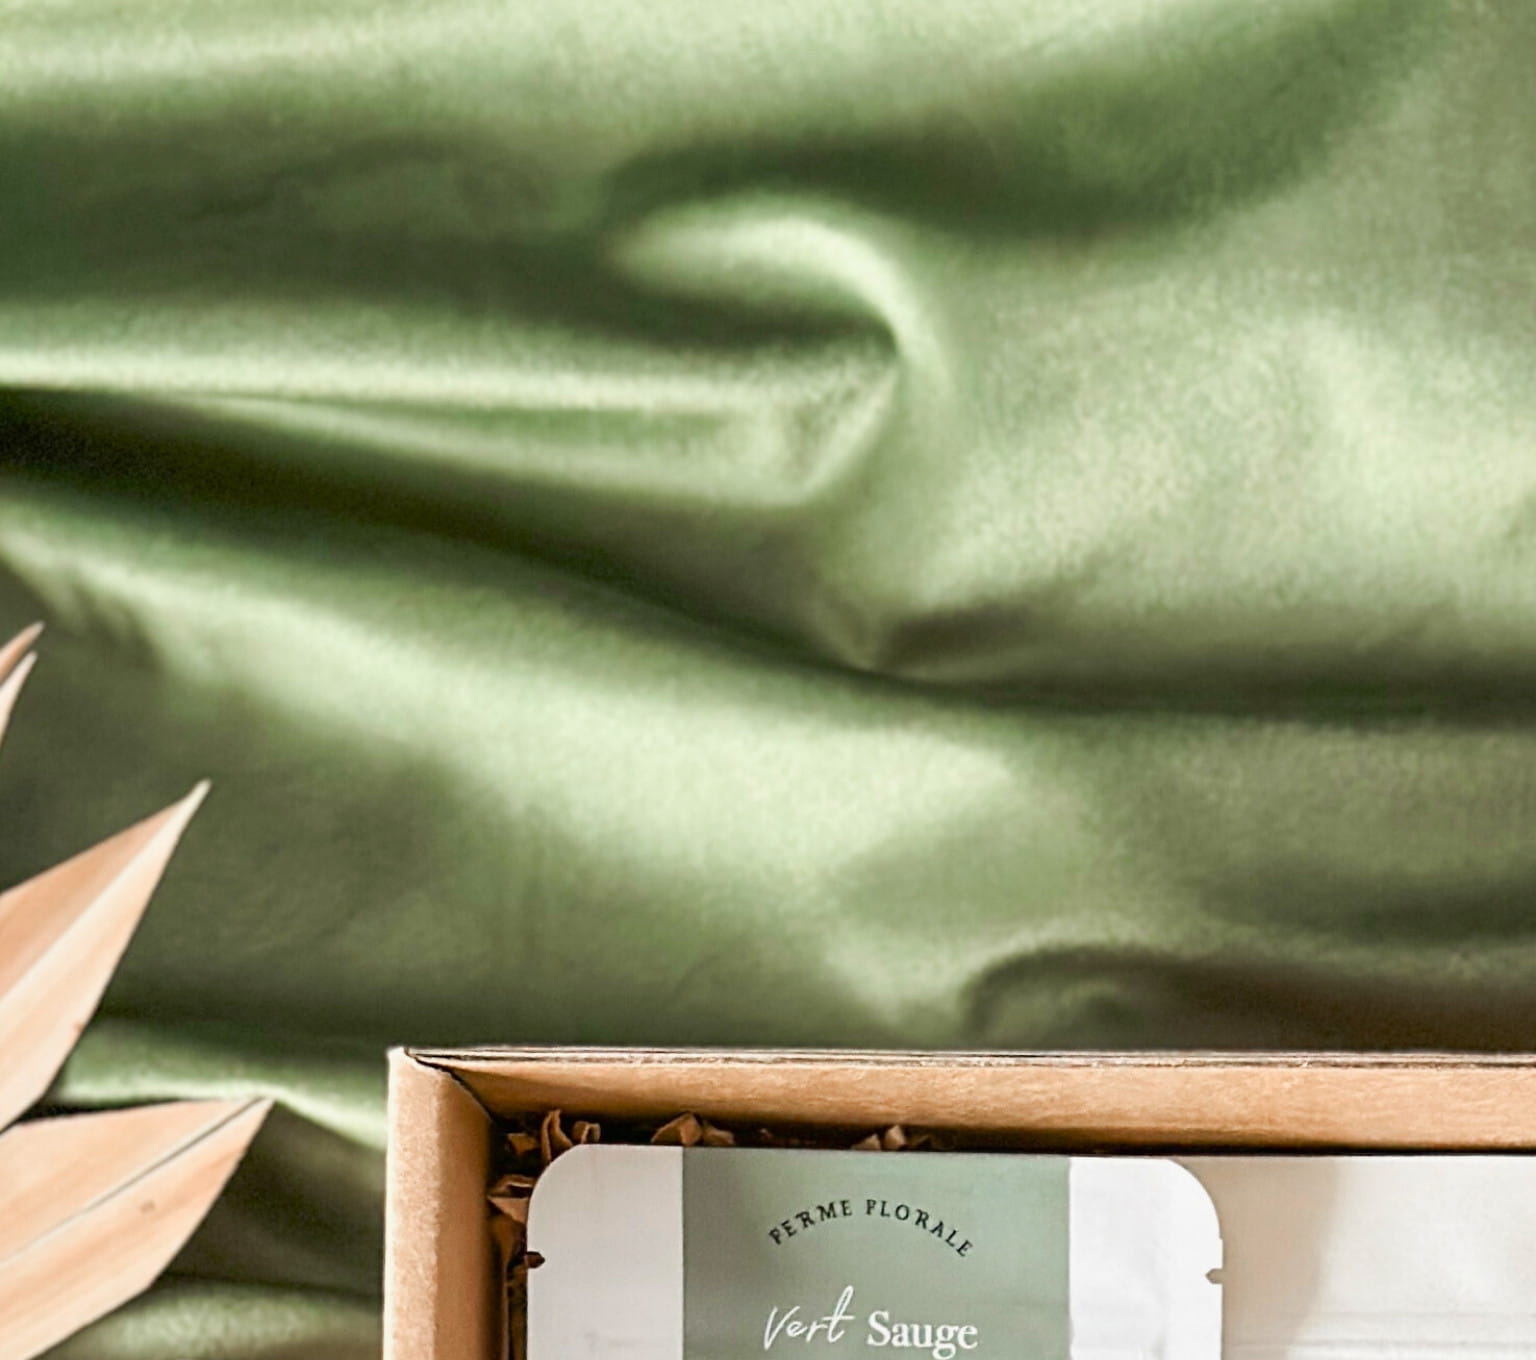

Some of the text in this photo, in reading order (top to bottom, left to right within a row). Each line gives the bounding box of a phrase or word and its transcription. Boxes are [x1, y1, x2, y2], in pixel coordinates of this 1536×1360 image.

[768, 1199, 974, 1257] FERME FLORALE
[867, 1311, 979, 1360] Sauge
